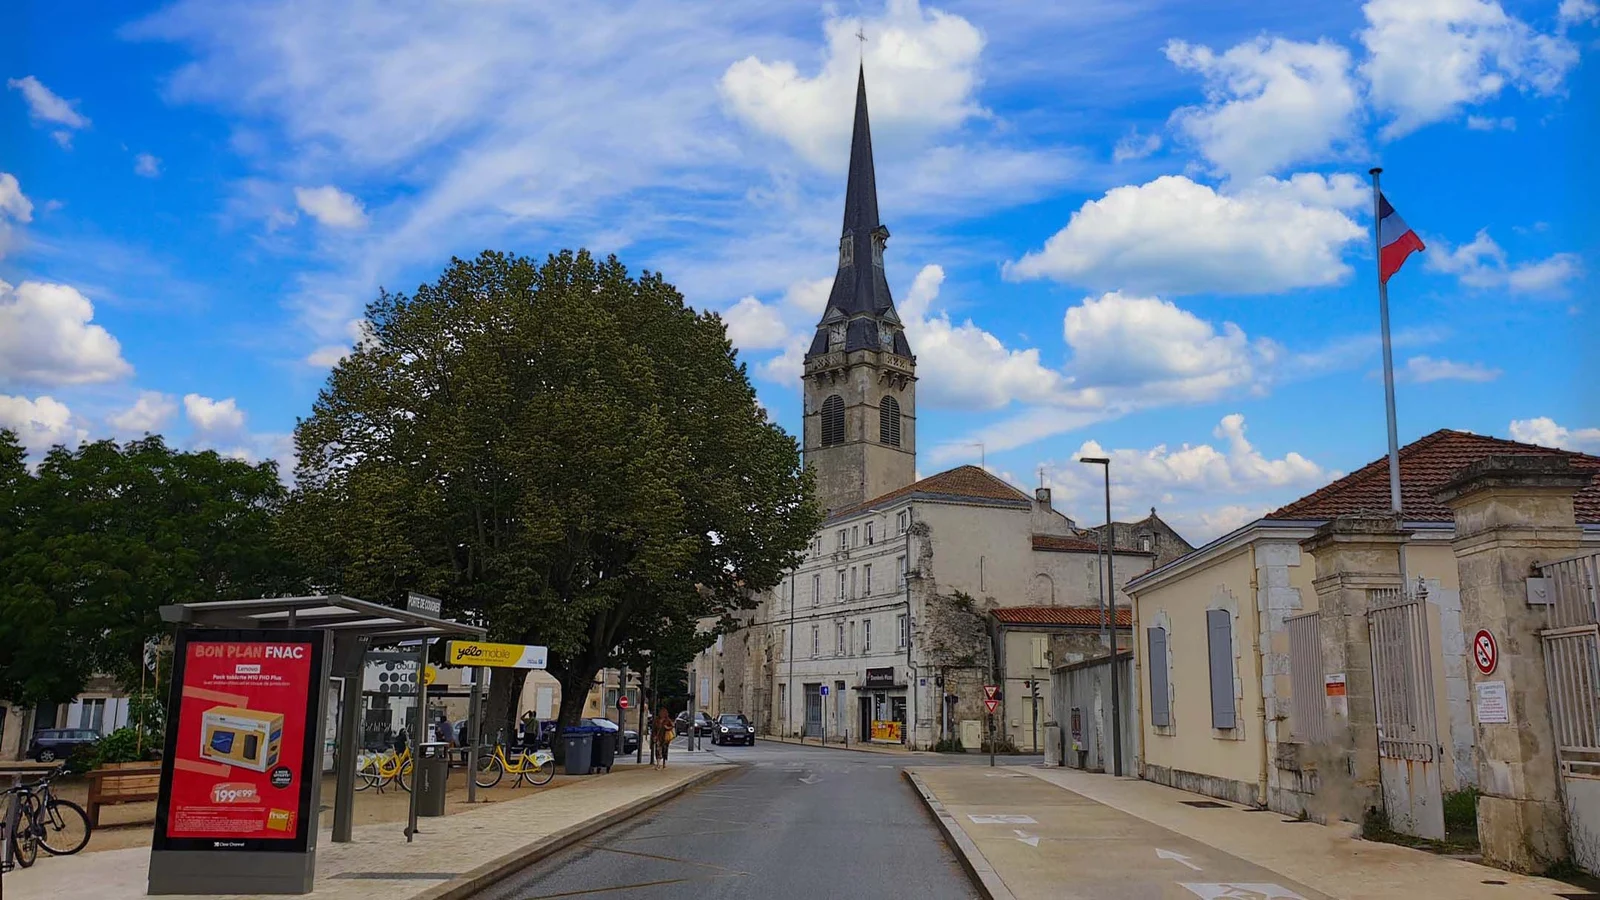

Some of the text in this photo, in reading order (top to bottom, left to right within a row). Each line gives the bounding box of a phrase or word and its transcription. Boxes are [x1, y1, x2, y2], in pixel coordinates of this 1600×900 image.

[195, 645, 304, 659] BON PLAN FNAC
